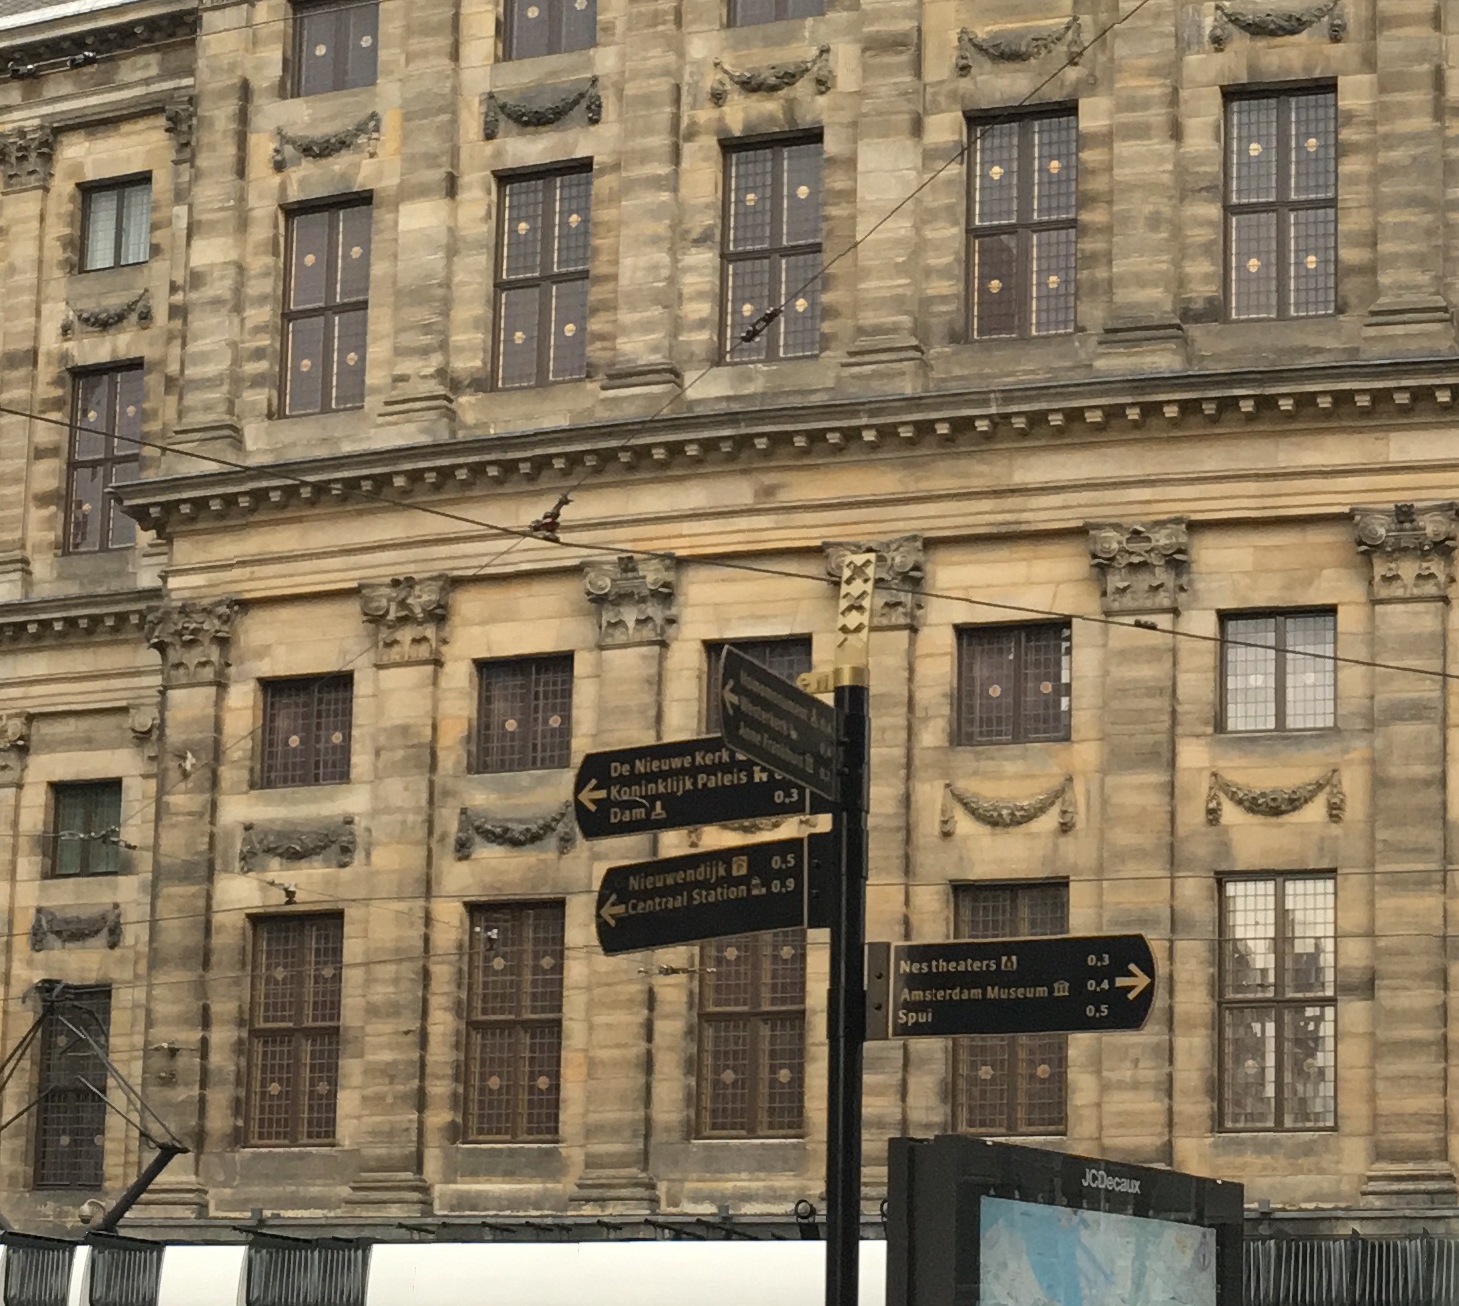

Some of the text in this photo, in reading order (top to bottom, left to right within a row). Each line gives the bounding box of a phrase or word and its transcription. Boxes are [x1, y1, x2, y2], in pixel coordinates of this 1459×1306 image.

[610, 748, 731, 777] De Nieuwe Kerk
[610, 768, 748, 801] Koninklijk Paleis
[609, 806, 646, 823] Dam
[628, 860, 727, 891] Nieuwendijk
[627, 892, 688, 914] Centraal
[692, 884, 748, 905] Station
[899, 959, 929, 974] Nes
[931, 958, 997, 973] theaters
[901, 987, 983, 1003] Amsterdam
[986, 985, 1049, 1000] Museum
[898, 1008, 933, 1026] Spui
[1082, 1168, 1141, 1195] JCDecaux
